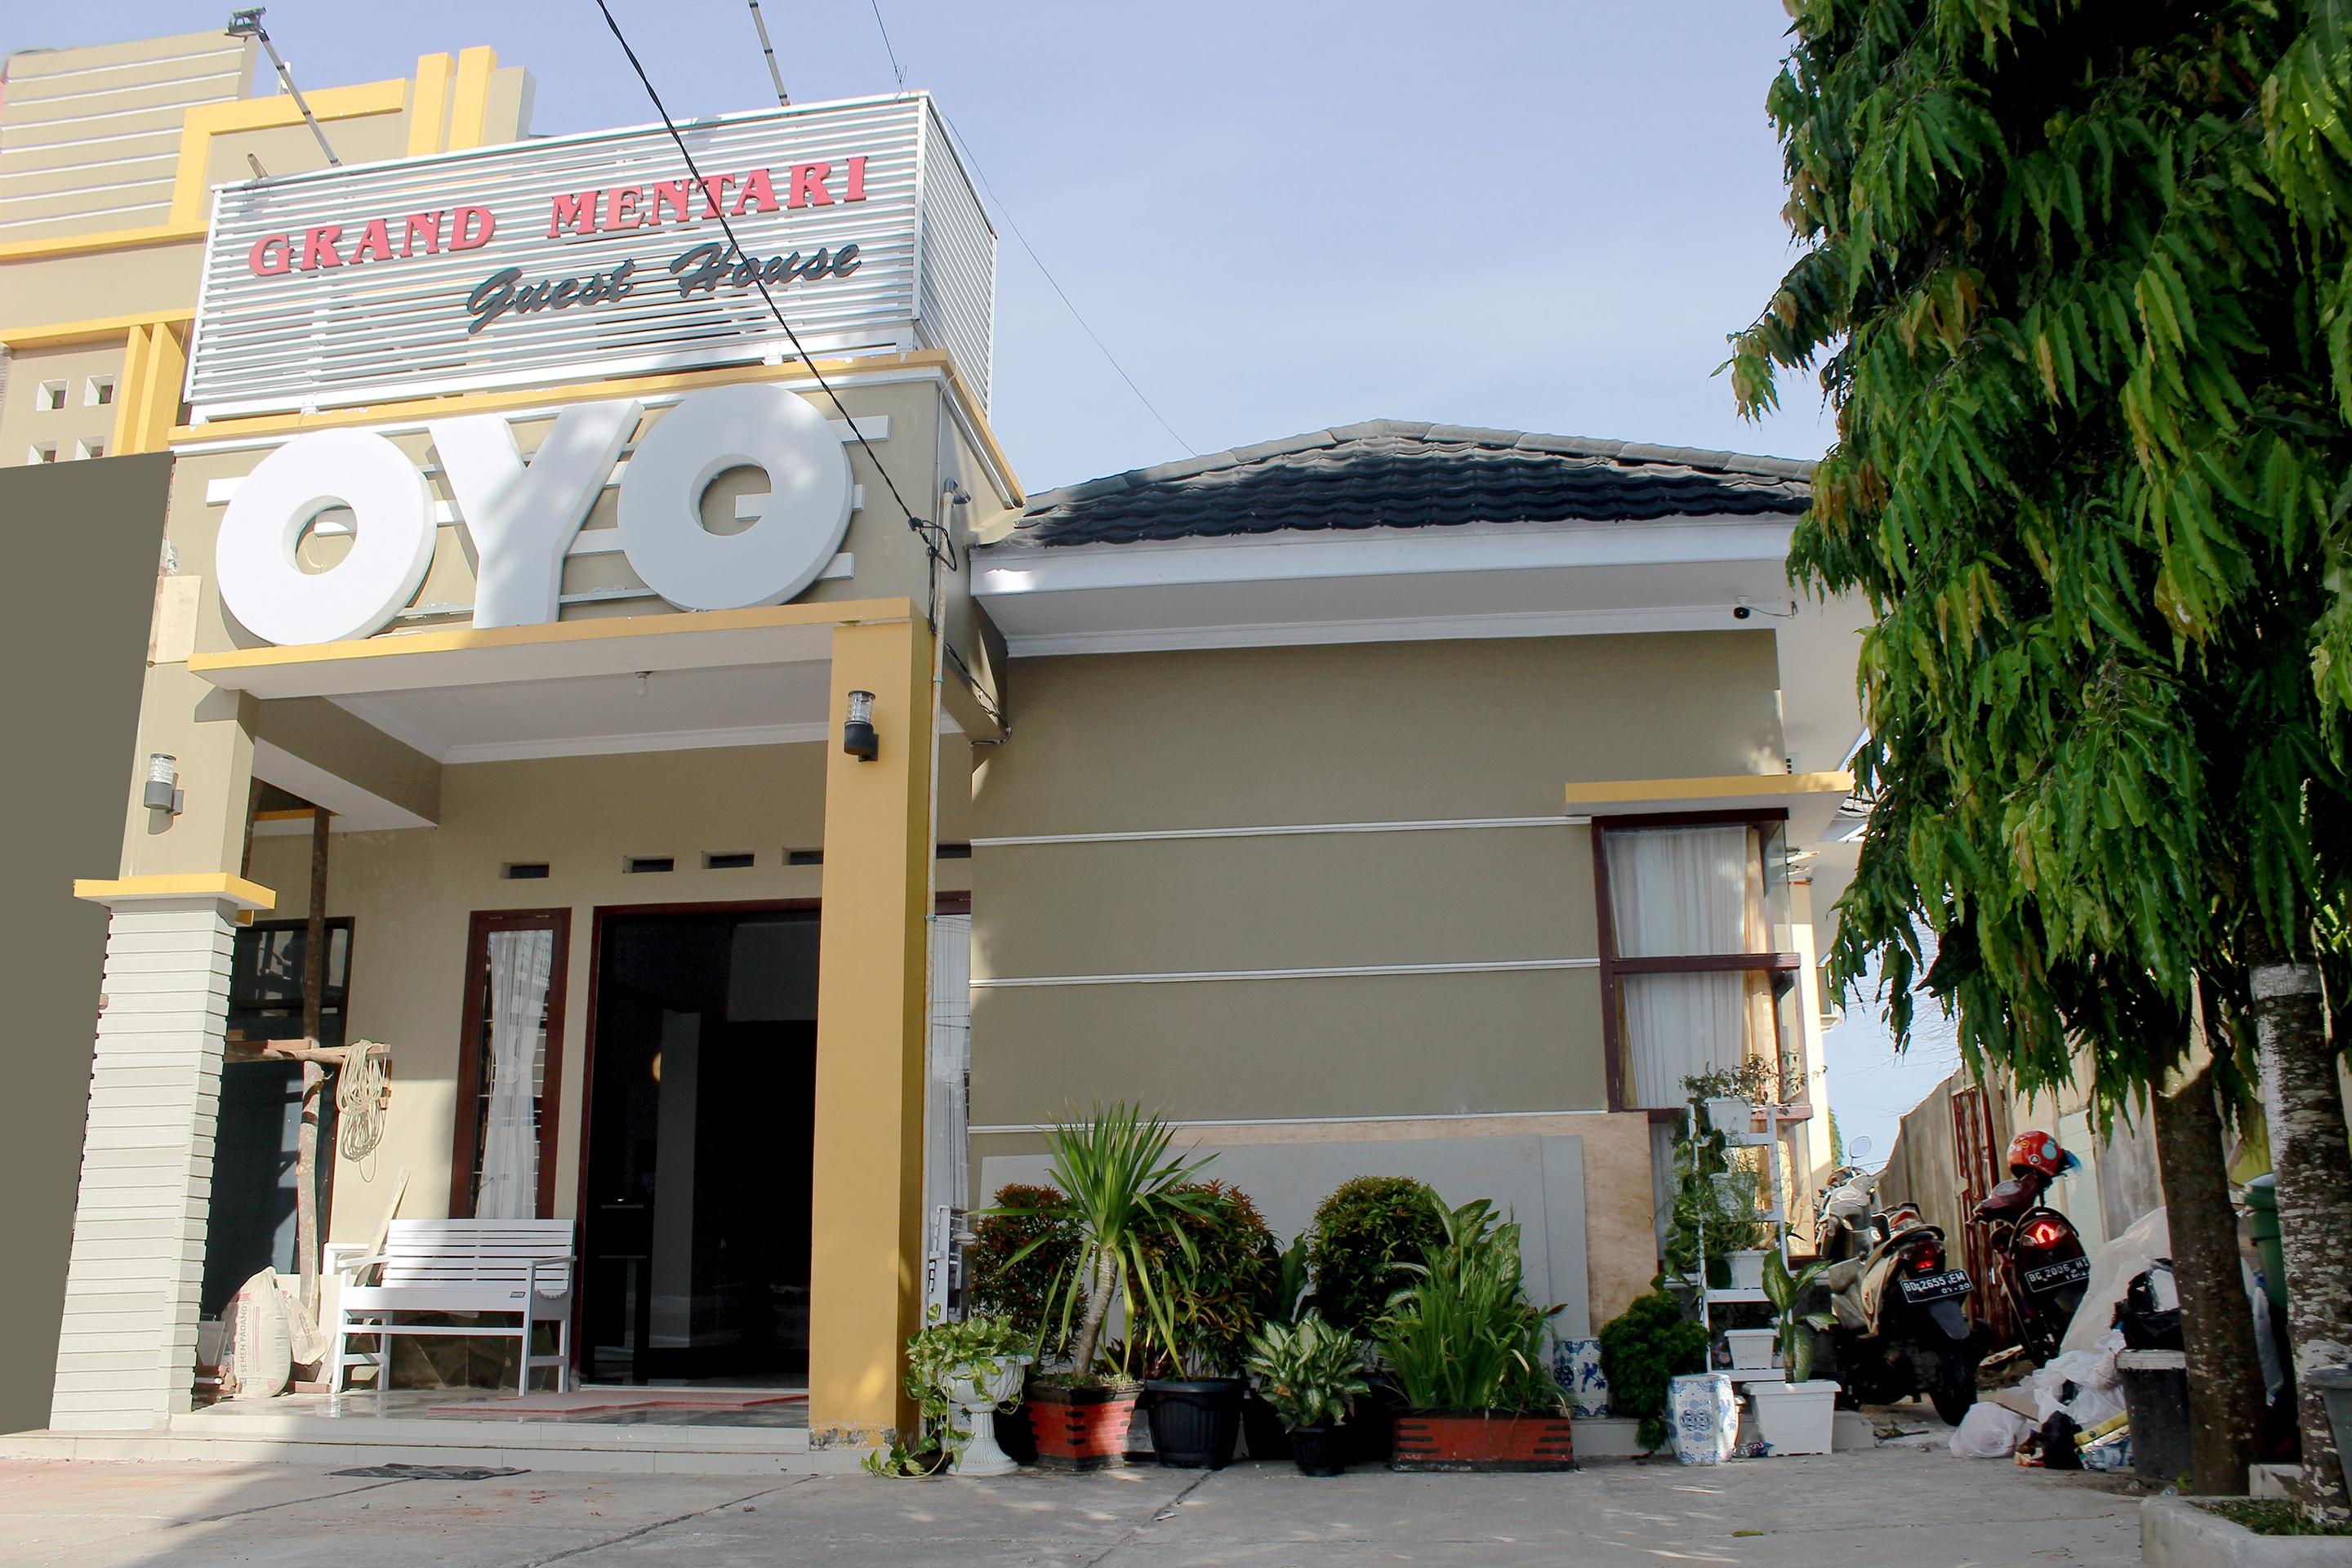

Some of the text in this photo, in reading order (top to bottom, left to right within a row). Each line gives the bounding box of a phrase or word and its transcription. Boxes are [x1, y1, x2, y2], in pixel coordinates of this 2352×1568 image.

[249, 156, 869, 278] GRAND MENTARI
[467, 243, 862, 333] Guest House
[1919, 1276, 1946, 1290] 2655
[1949, 1272, 1966, 1285] EM
[2045, 1263, 2070, 1277] 2006
[239, 1306, 248, 1373] SEMEN PADANG
